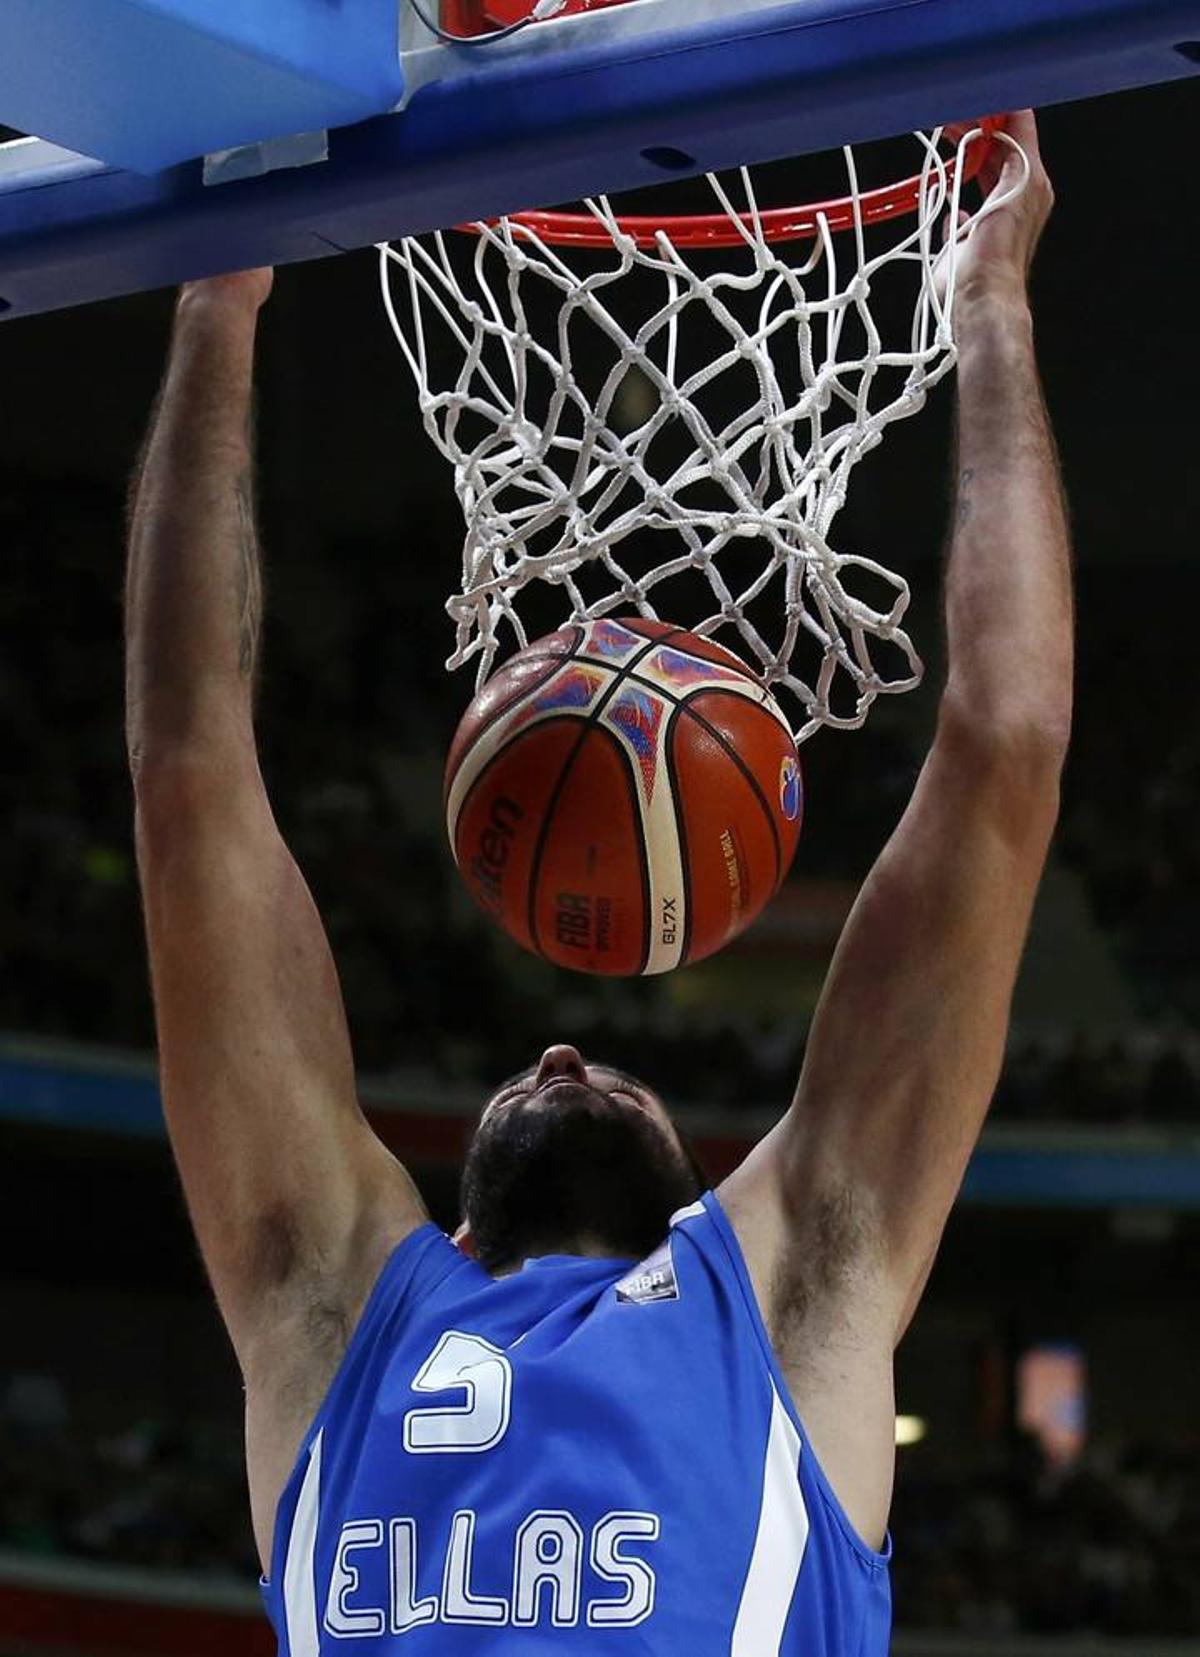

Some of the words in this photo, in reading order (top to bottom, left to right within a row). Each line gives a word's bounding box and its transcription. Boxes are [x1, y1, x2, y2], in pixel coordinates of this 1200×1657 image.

[555, 893, 590, 950] FIBA
[662, 898, 676, 944] GL7X
[324, 1509, 660, 1638] ELLAS
